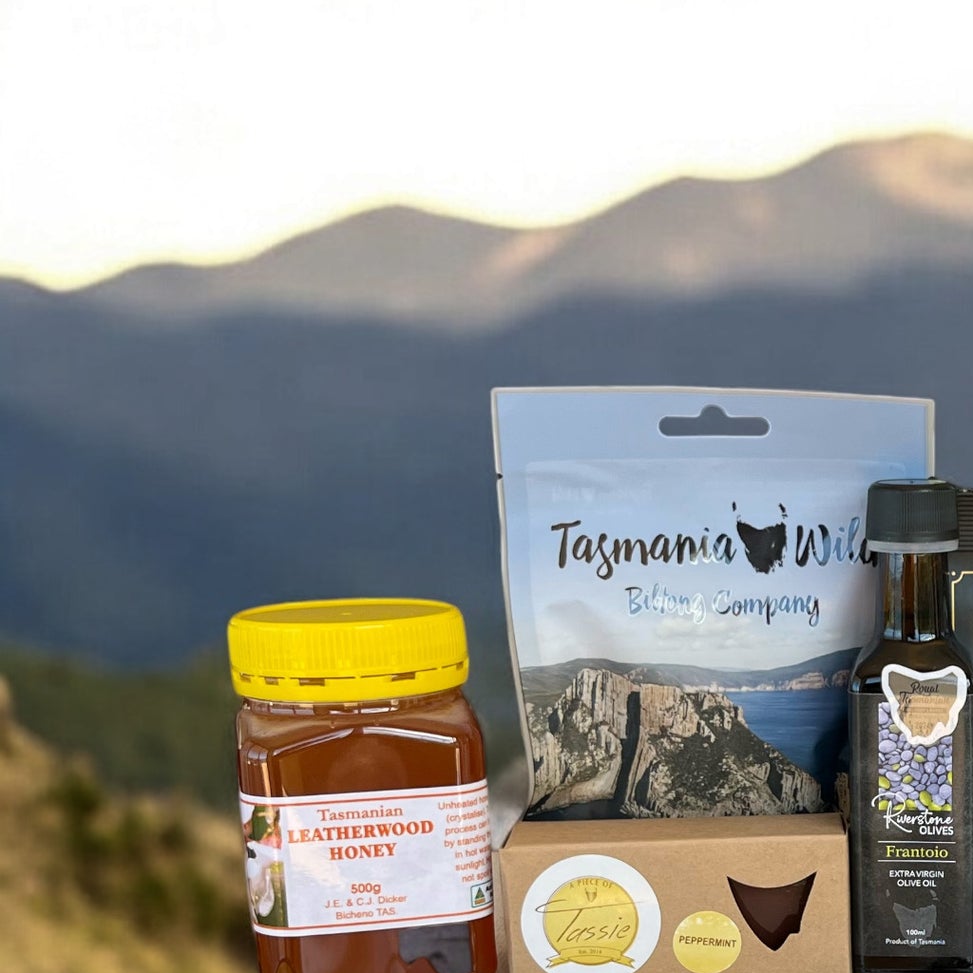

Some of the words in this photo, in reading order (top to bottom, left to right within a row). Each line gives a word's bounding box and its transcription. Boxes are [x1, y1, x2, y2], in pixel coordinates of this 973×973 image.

[551, 520, 736, 580] Tasmania
[625, 583, 706, 624] Biltong
[711, 589, 820, 627] Company
[438, 798, 478, 810] Unheated
[316, 805, 403, 822] Tasmanian
[872, 792, 954, 833] Riverstone
[288, 820, 434, 844] LEATHERWOOD
[445, 824, 477, 836] process
[919, 826, 954, 836] OLIVES
[444, 840, 455, 848] by
[329, 842, 397, 861] HONEY
[455, 850, 463, 858] in
[466, 848, 478, 856] hot
[886, 844, 949, 858] Frantoio
[462, 874, 474, 882] not
[889, 870, 915, 878] EXTRA
[916, 870, 944, 878] VIRGIN
[350, 883, 382, 895] 500g
[897, 879, 922, 888] OLIVE
[922, 879, 937, 888] OIL
[324, 898, 342, 908] J.E.
[346, 898, 354, 907] &
[356, 896, 374, 906] C.J.
[378, 894, 408, 904] Dicker
[336, 908, 374, 920] Bicheno
[536, 900, 643, 942] Tassie
[678, 935, 736, 949] PEPPERMINT
